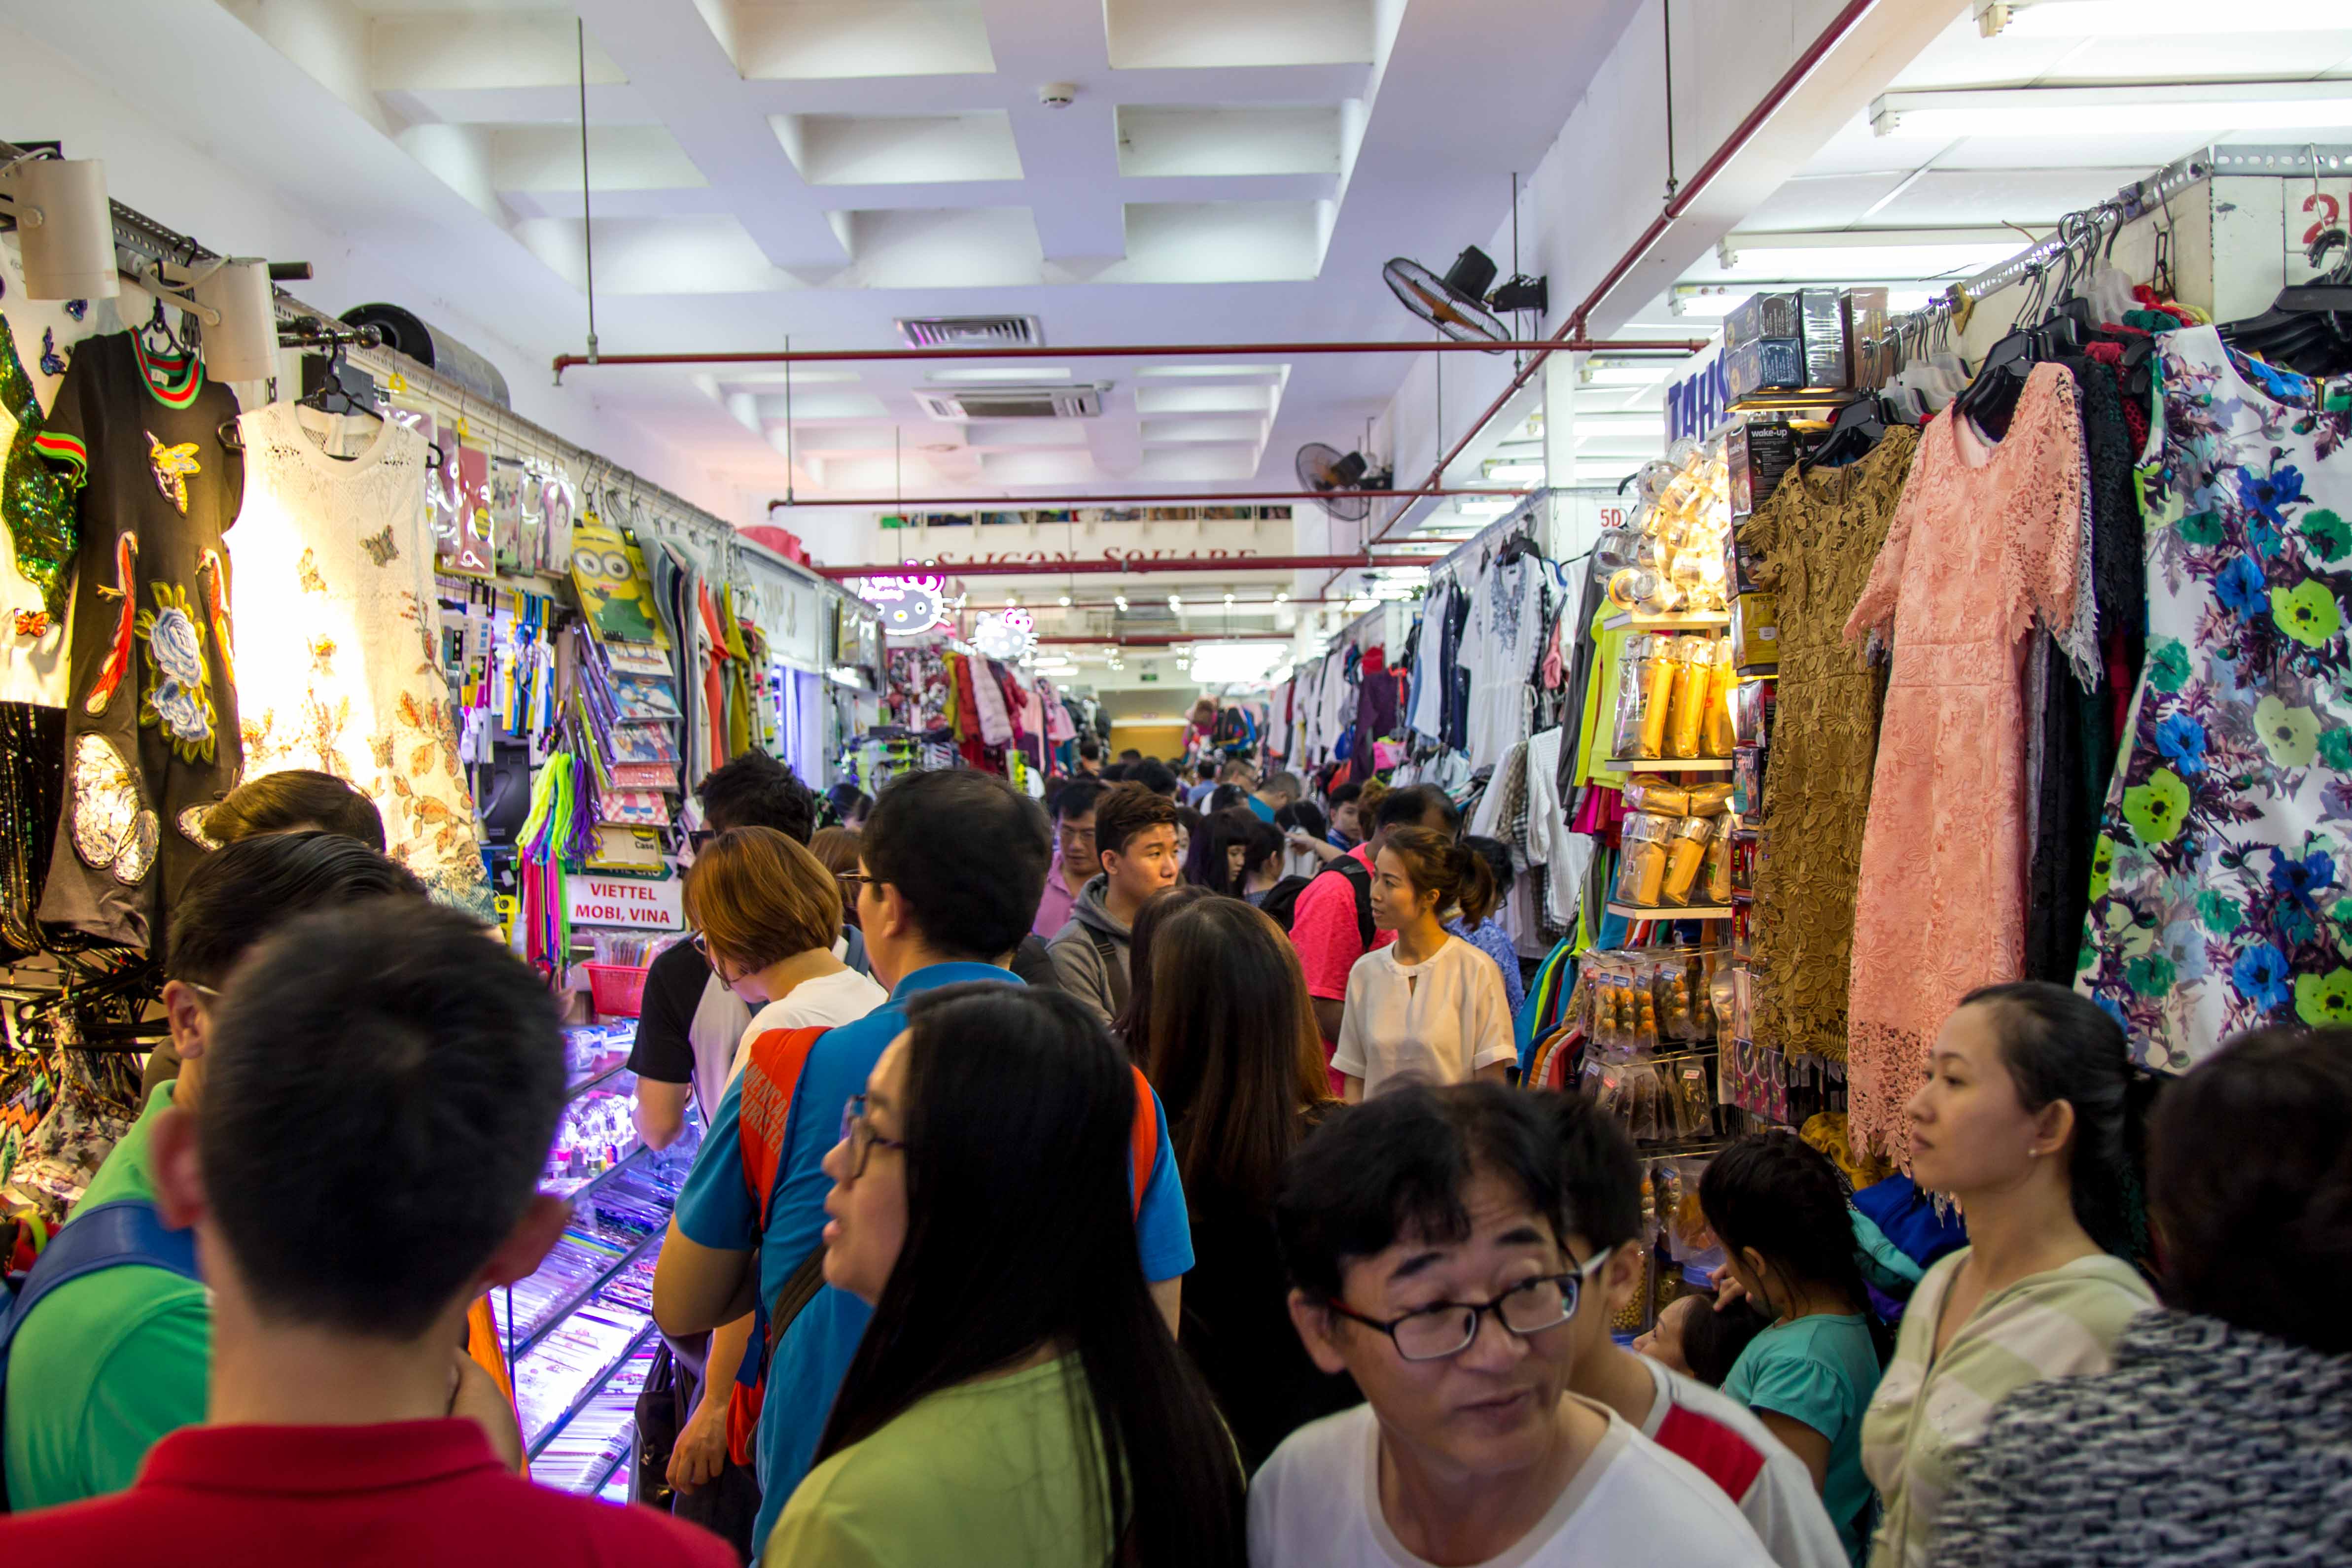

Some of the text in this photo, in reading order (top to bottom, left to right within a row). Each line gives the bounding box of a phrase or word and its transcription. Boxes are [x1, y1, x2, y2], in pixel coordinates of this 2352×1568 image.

[1751, 428, 1788, 438] wake-up
[1601, 509, 1621, 527] 5D
[635, 840, 655, 849] Case
[590, 883, 657, 901] VIETTEL
[575, 904, 670, 924] MOBI, VINA
